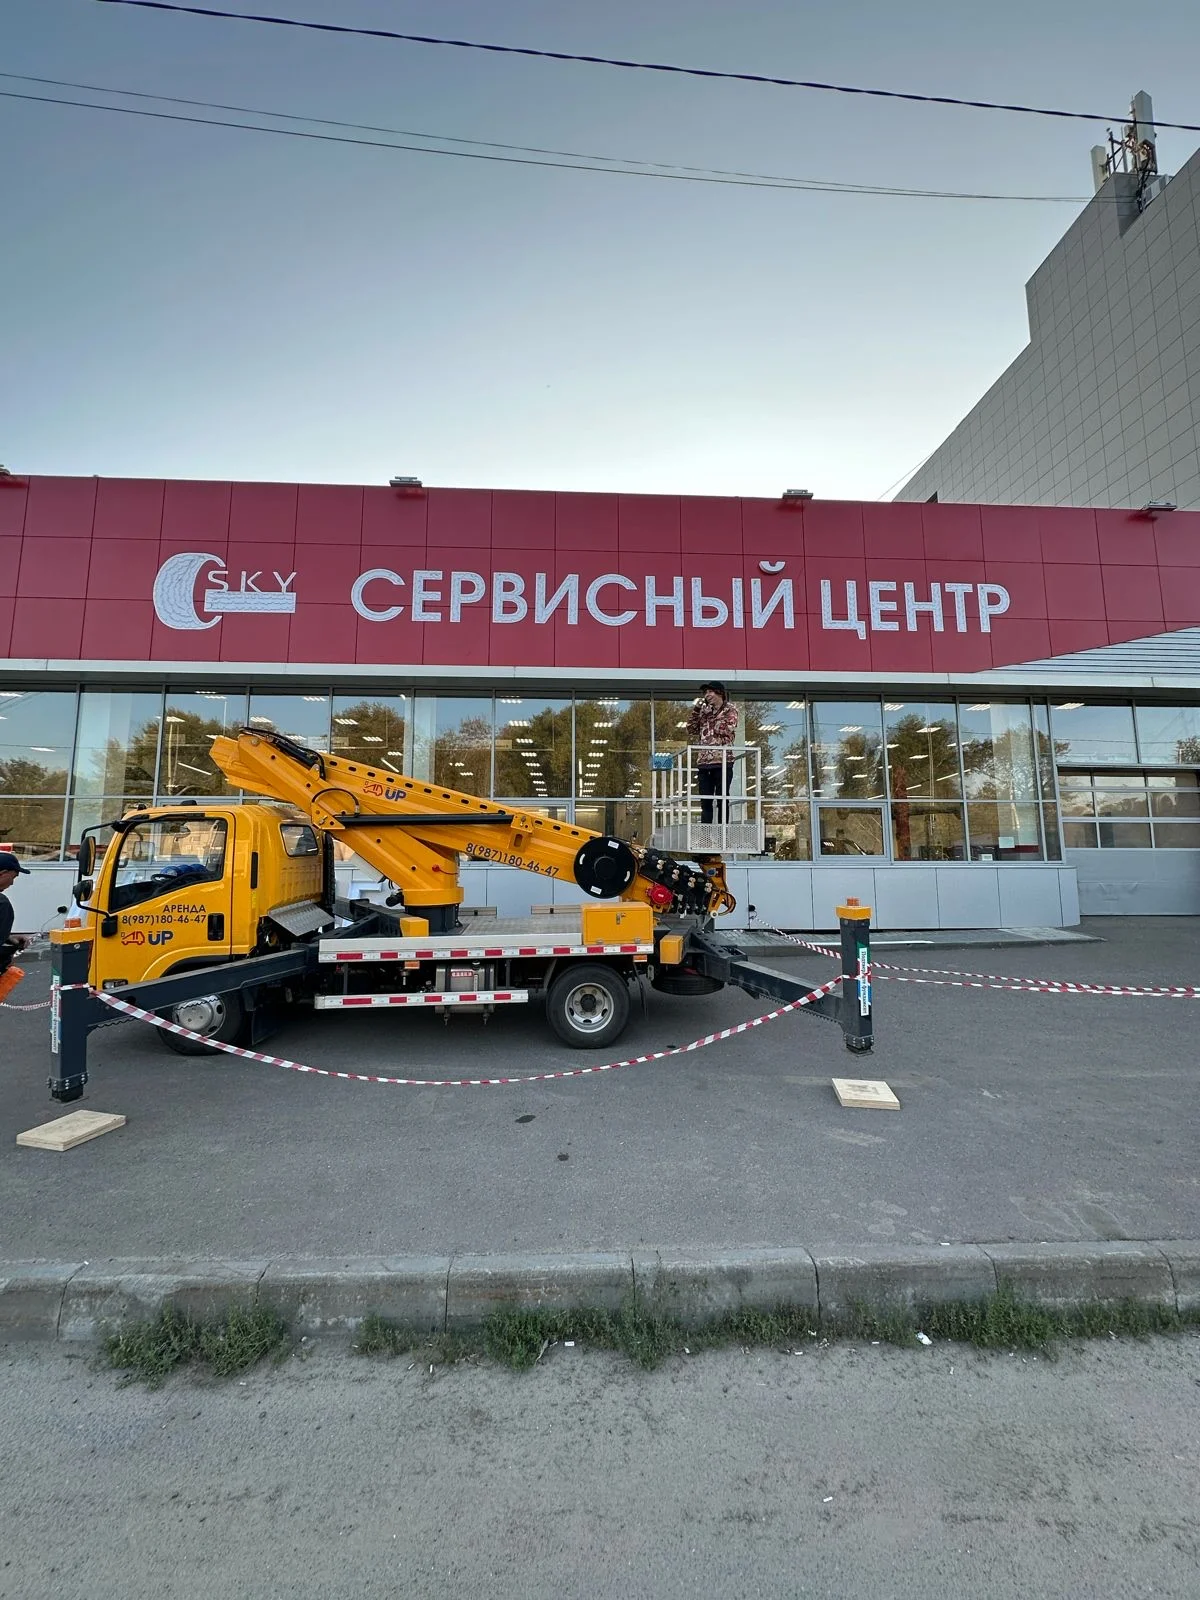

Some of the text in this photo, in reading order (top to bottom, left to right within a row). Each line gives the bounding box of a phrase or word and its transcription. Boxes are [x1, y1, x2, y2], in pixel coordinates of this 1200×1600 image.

[350, 560, 1011, 640] СЕРВИСНЫЙ ЦЕНТР
[465, 842, 560, 877] 8(987)180-46-47
[122, 914, 206, 925] 8(987)180-46-47
[163, 905, 206, 914] АРЕНДА
